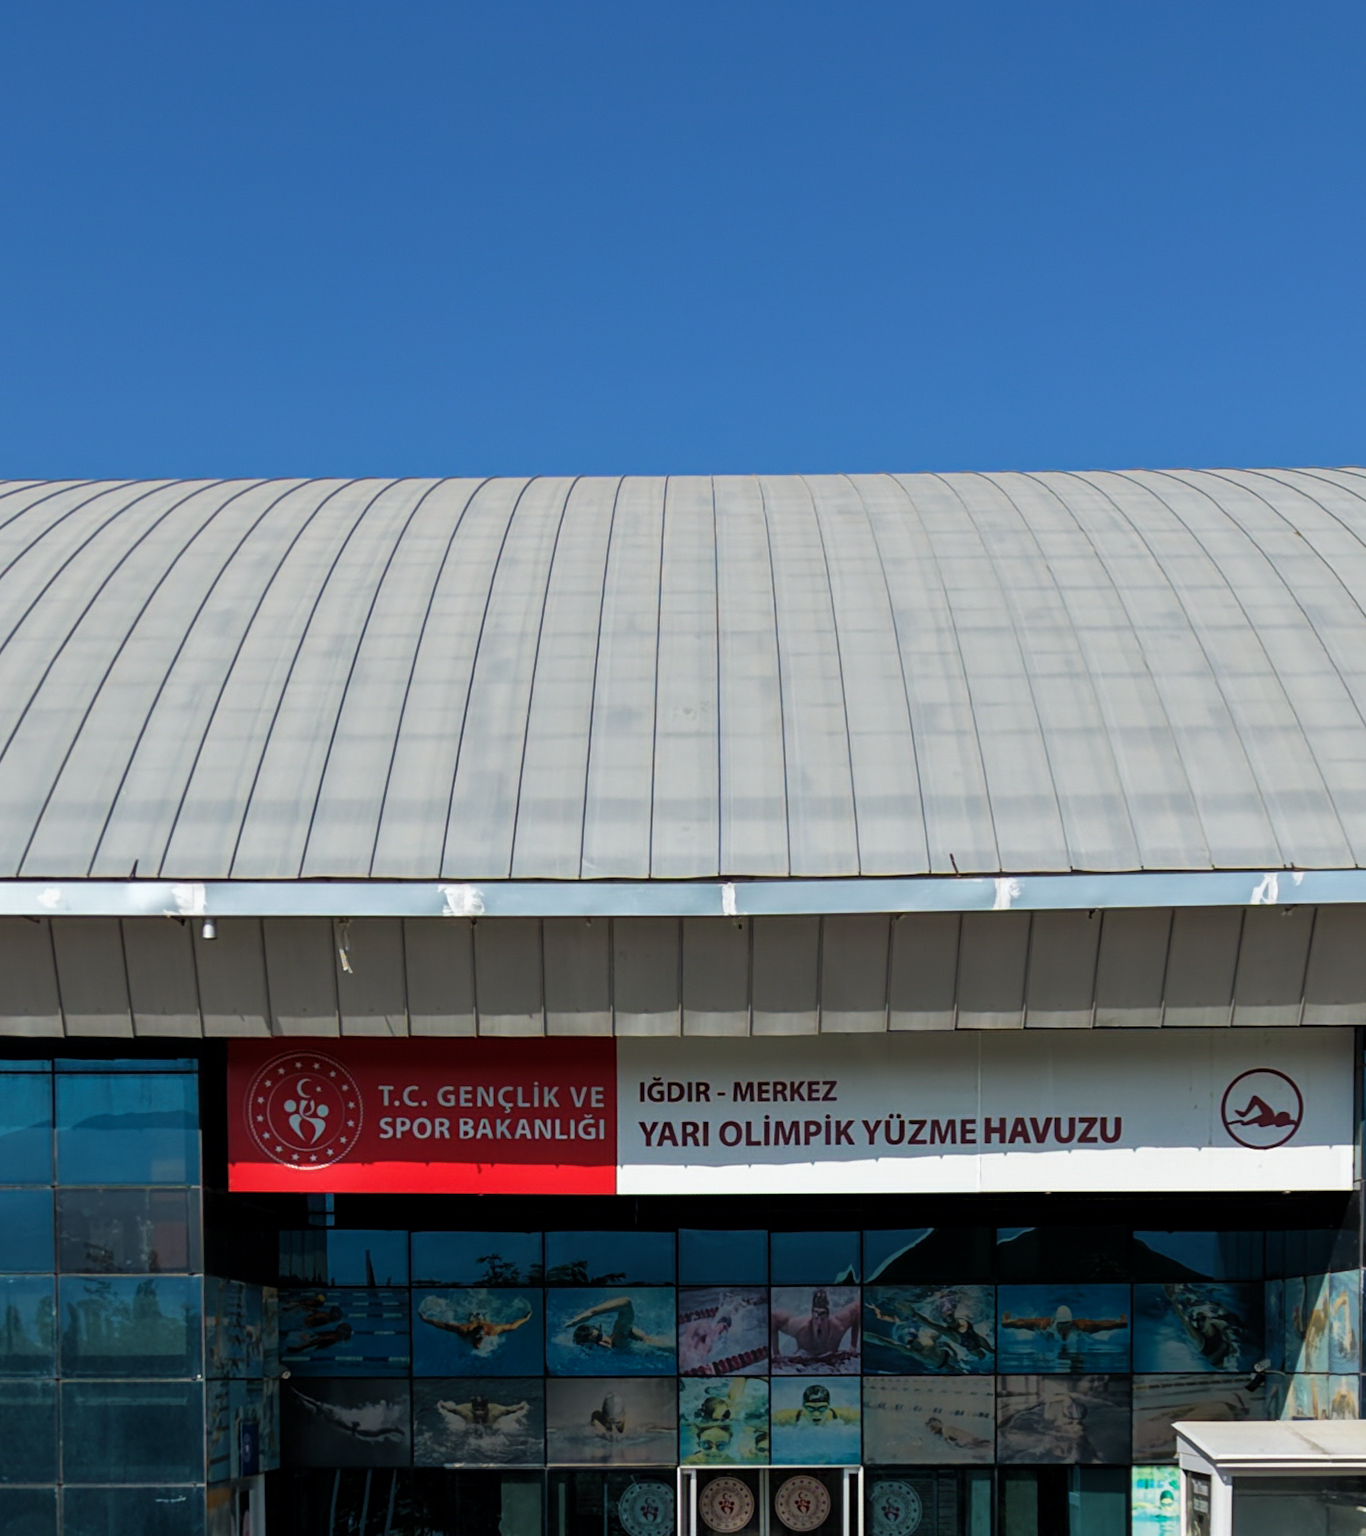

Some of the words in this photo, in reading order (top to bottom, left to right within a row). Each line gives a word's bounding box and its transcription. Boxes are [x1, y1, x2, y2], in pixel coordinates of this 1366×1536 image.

[378, 1085, 428, 1107] T.C.
[437, 1081, 560, 1114] GENÇLİK
[570, 1086, 605, 1108] VE
[639, 1076, 711, 1103] IĞDIR
[732, 1080, 838, 1103] MERKEZ
[379, 1117, 450, 1139] SPOR
[459, 1114, 605, 1140] BAKANLIĞI
[637, 1120, 710, 1147] YARI
[718, 1113, 856, 1147] OLİMPİK
[861, 1112, 977, 1146] YÜZME
[983, 1116, 1123, 1145] HAVUZU
